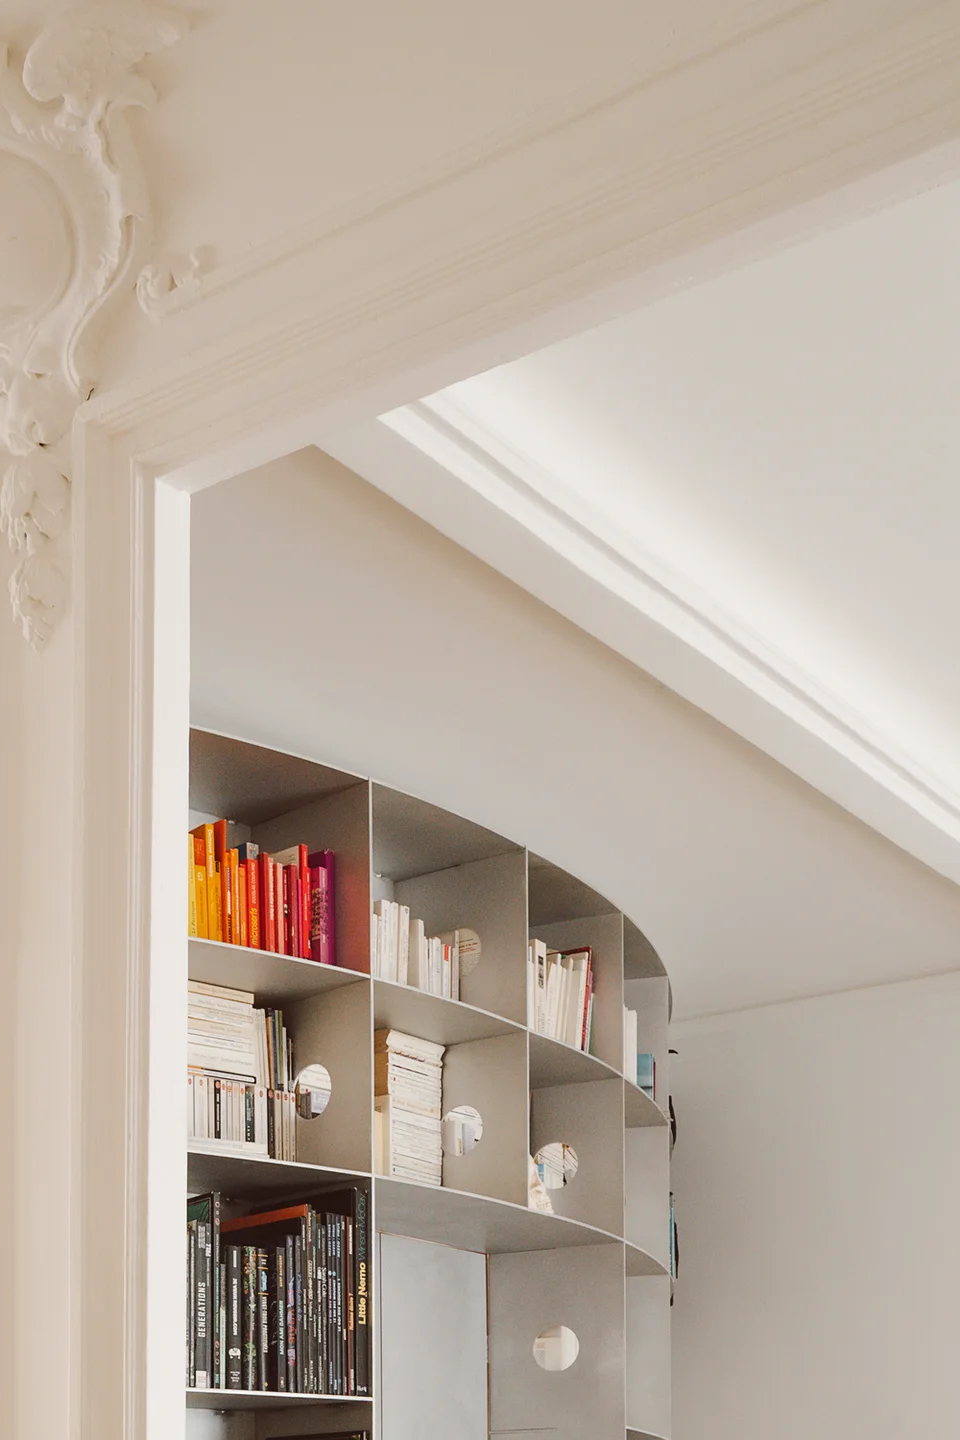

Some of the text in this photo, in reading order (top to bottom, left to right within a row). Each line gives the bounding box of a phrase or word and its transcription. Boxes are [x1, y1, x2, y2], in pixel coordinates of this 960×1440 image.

[249, 908, 258, 946] microserfs
[358, 1192, 367, 1261] Winsor McCay
[198, 1282, 207, 1338] GENERATIONS
[358, 1263, 368, 1325] Little Nemo
